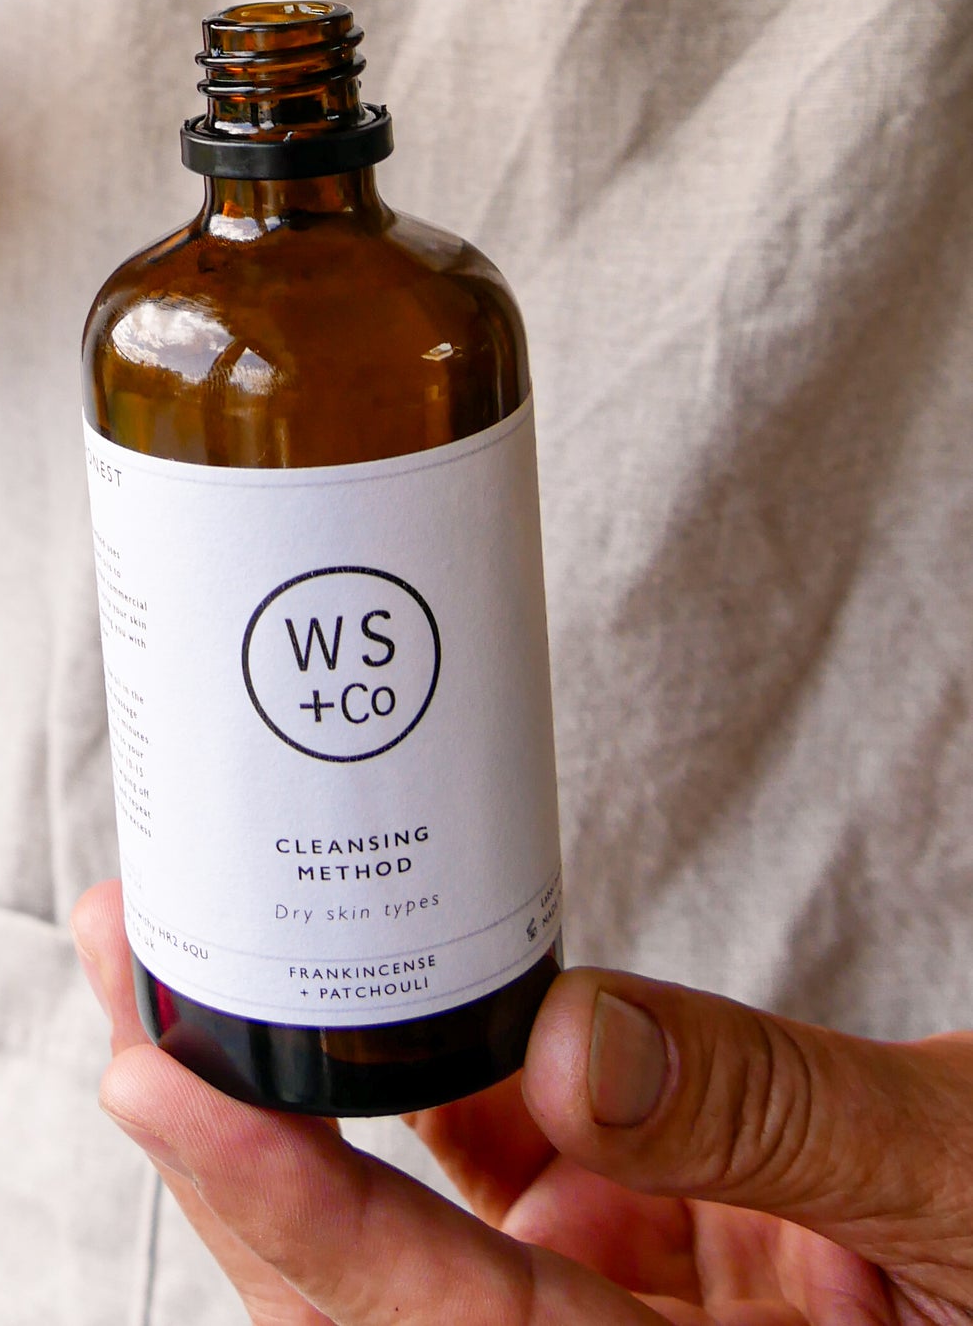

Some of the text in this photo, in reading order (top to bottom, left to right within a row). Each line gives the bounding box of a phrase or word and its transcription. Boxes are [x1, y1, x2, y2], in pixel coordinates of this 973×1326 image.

[130, 615, 147, 630] skin
[129, 634, 147, 649] with
[275, 825, 429, 855] CLEANSING
[297, 857, 412, 881] METHOD
[274, 893, 439, 924] Dry skin types
[158, 926, 178, 948] HR2
[182, 940, 209, 960] 6QU
[289, 954, 436, 980] FRANKINCENSE
[319, 976, 429, 1000] PATCHOULI
